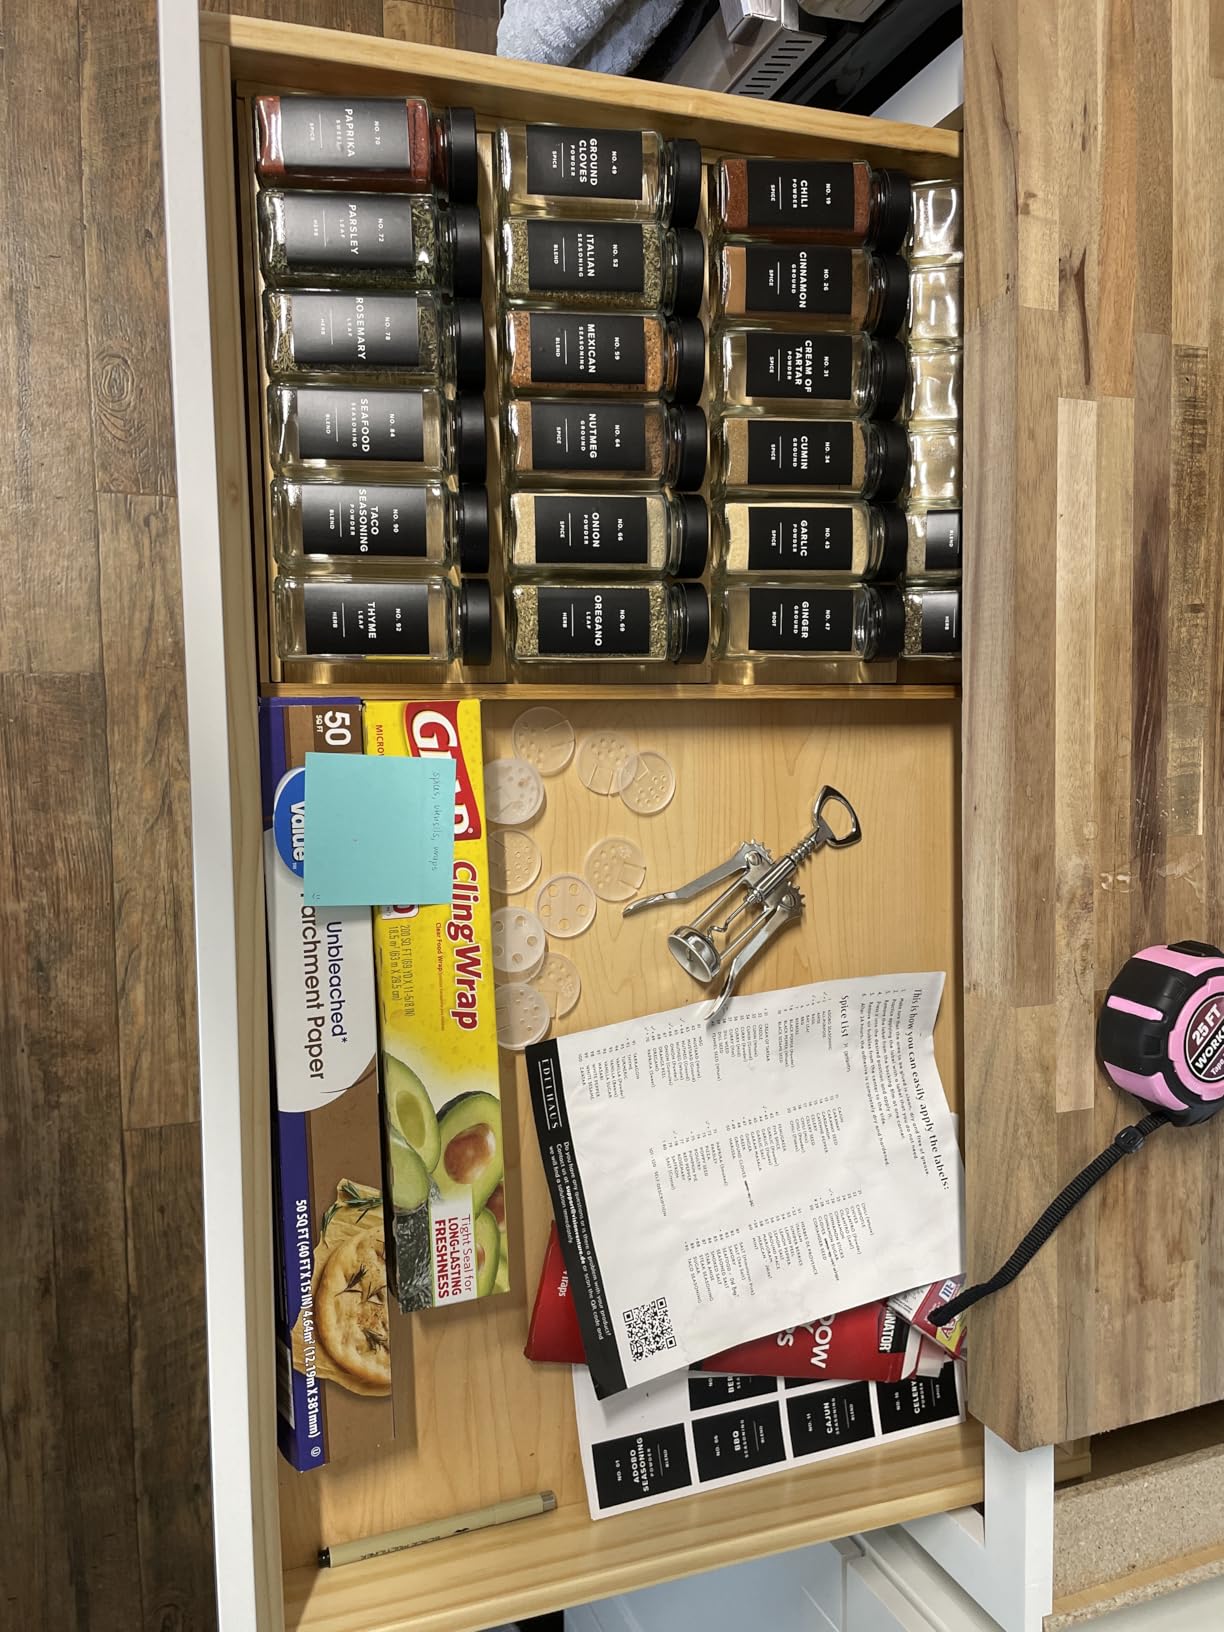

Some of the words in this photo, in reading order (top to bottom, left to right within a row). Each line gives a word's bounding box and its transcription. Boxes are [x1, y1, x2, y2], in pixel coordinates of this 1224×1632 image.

[344, 109, 355, 157] PAPRIKA
[579, 140, 588, 183] CLOVES
[589, 138, 598, 186] GROUND
[612, 166, 618, 174] 49
[800, 180, 808, 208] CHILI
[826, 197, 831, 205] 19
[348, 205, 359, 254] PARSLEY
[378, 234, 384, 242] 72
[586, 234, 595, 276] ITALIAN
[613, 259, 619, 268] 52
[798, 252, 807, 308] CINNAMON
[824, 283, 829, 291] 26
[355, 297, 367, 360] ROSEMARY
[385, 332, 391, 340] 78
[587, 324, 596, 373] MEXICAN
[615, 351, 620, 360] 59
[795, 347, 803, 385] TARTAR
[805, 378, 812, 393] OF
[361, 399, 370, 452] SEAFOOD
[390, 428, 395, 437] 84
[589, 414, 597, 458] NUTMEG
[615, 439, 620, 447] 64
[800, 436, 808, 469] CUMIN
[825, 455, 830, 463] 34
[359, 489, 368, 552] SEASONING
[370, 506, 379, 535] TACO
[393, 524, 399, 533] 90
[592, 512, 600, 547] ONION
[618, 532, 623, 541] 66
[800, 520, 808, 556] GARLIC
[825, 541, 830, 549] 43
[367, 602, 377, 639] THYME
[396, 623, 402, 632] 92
[594, 595, 603, 646] OREGANO
[620, 624, 625, 632] 69
[801, 601, 809, 638] GINGER
[316, 714, 322, 725] SQ
[324, 710, 352, 746] 50
[446, 860, 480, 943] Cling
[400, 925, 411, 936] 200
[301, 905, 324, 1010] archment
[402, 949, 412, 957] FT
[403, 971, 413, 979] YD
[450, 944, 482, 1030] Wrap
[839, 995, 850, 1019] Spice
[912, 989, 922, 1004] This
[908, 1013, 918, 1029] how
[910, 1005, 918, 1013] is
[841, 1021, 849, 1037] List
[1192, 1022, 1209, 1046] 25
[1204, 1003, 1221, 1027] FT
[304, 1017, 326, 1080] Paper
[905, 1032, 915, 1049] you
[908, 1051, 917, 1069] can
[541, 1059, 559, 1129] EDELHAUS
[911, 1071, 925, 1101] easily
[919, 1104, 934, 1133] apply
[928, 1135, 941, 1153] the
[933, 1155, 950, 1190] labels:
[296, 1200, 307, 1212] 50
[296, 1214, 308, 1228] SQ
[460, 1214, 471, 1247] Tight
[298, 1229, 310, 1240] FT
[297, 1241, 309, 1258] (40
[434, 1219, 449, 1299] FRESHNESS
[448, 1217, 461, 1296] LONG-LASTING
[462, 1250, 473, 1272] Seal
[299, 1259, 310, 1271] FT
[300, 1270, 311, 1280] X
[301, 1280, 312, 1292] 15
[464, 1275, 474, 1292] for
[300, 1294, 314, 1309] IN)
[303, 1346, 318, 1386] (12.19m
[307, 1388, 318, 1397] X
[911, 1380, 921, 1414] CELERY
[306, 1397, 321, 1438] 381mm)
[823, 1402, 833, 1434] CAJUN
[732, 1430, 741, 1451] BBQ
[630, 1449, 640, 1483] ADOBO
[636, 1437, 650, 1492] SEASONING
